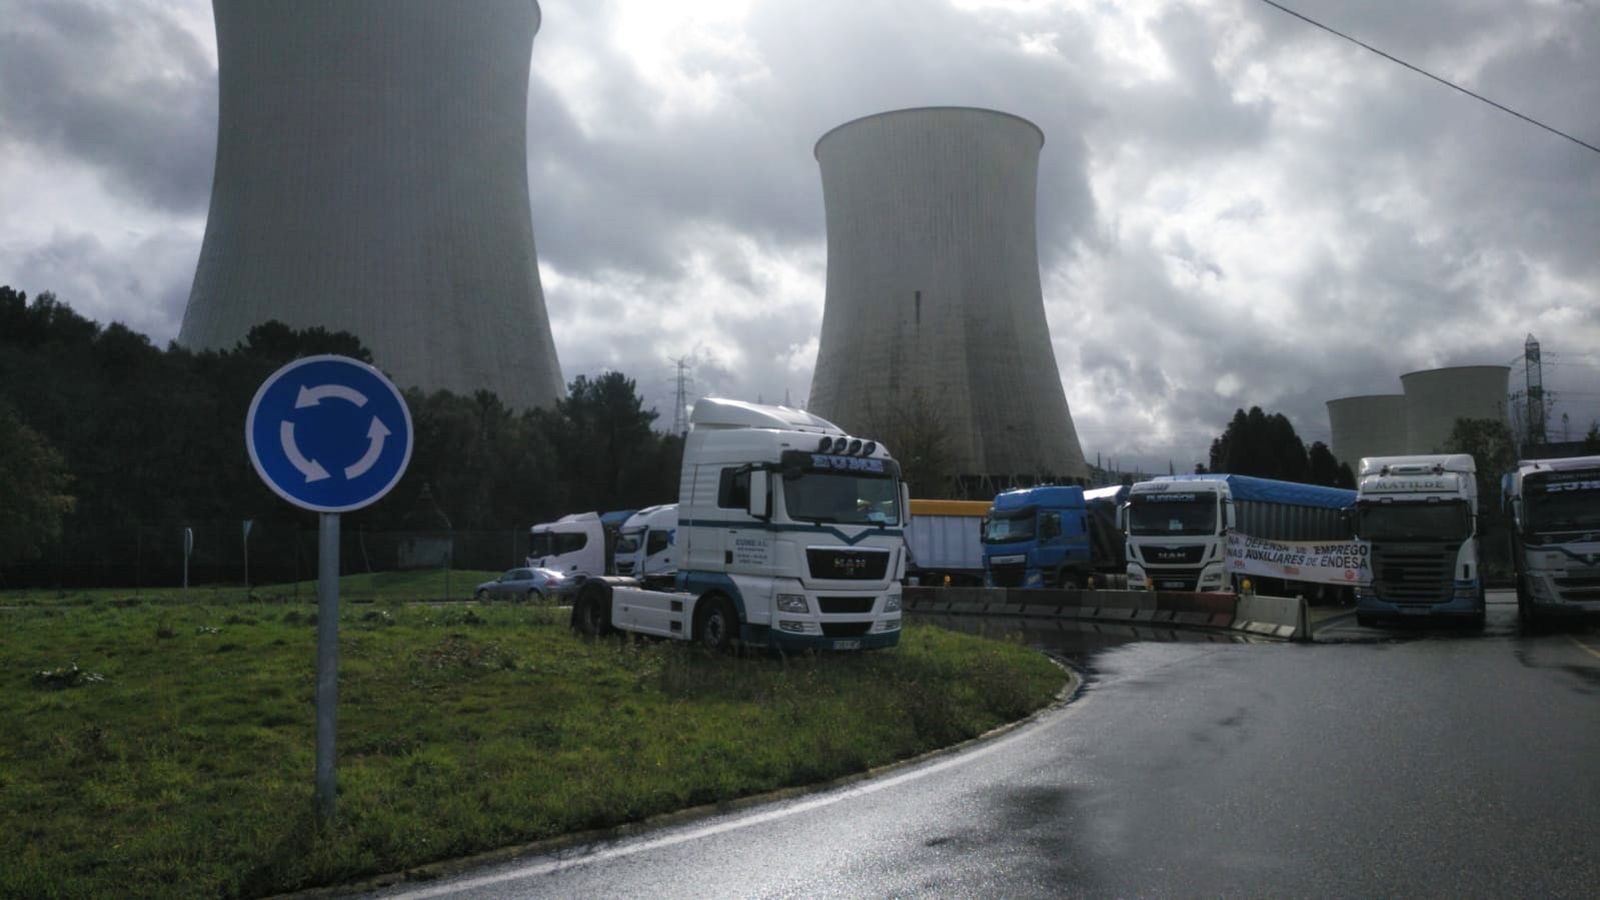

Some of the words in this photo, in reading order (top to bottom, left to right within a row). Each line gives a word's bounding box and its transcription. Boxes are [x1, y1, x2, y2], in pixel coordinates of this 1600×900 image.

[1376, 480, 1445, 489] MATILDE
[1314, 544, 1368, 556] EMPREGO
[1227, 548, 1243, 558] NAS
[1245, 549, 1305, 565] AUXILIARES
[1306, 557, 1319, 566] DE
[1320, 556, 1368, 569] ENDESA
